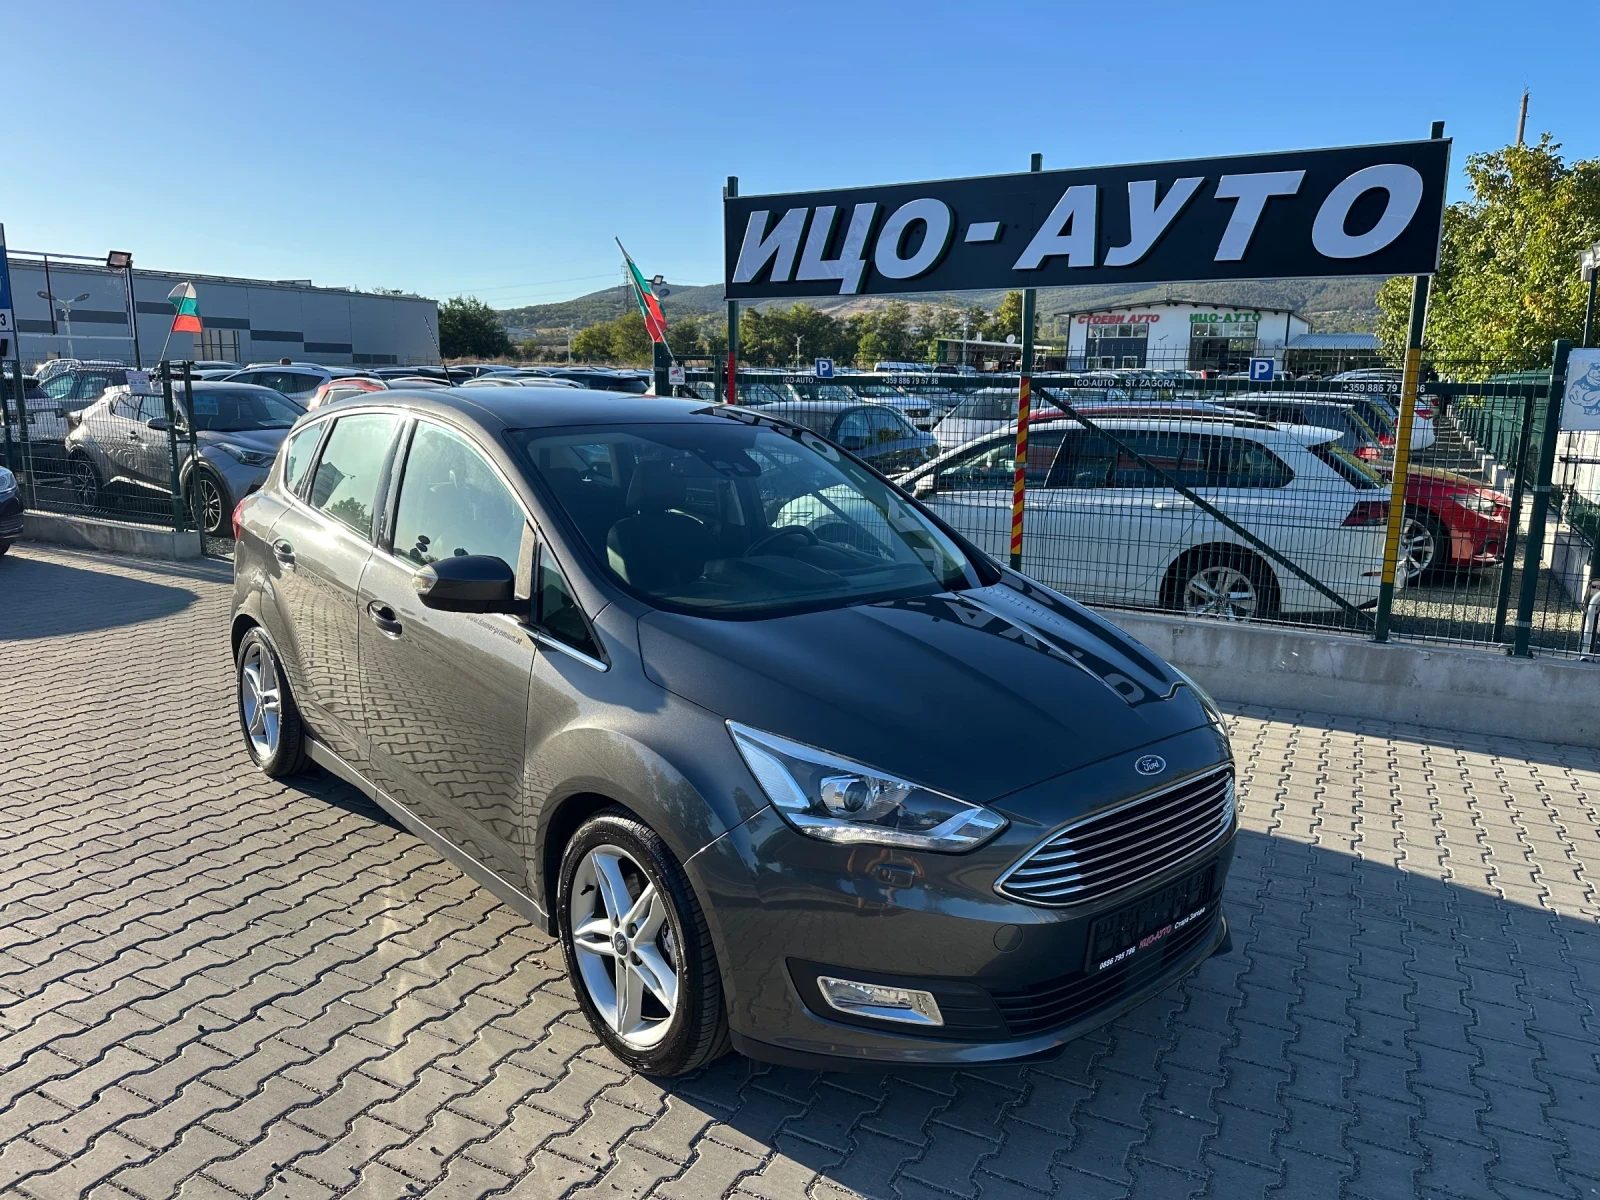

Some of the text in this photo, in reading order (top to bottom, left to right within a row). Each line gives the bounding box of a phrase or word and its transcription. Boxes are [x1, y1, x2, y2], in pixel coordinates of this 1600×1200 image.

[1077, 313, 1160, 325] СТОЕВИ АУТО
[1189, 312, 1262, 323] ИЦО-АУТО
[819, 361, 830, 376] P
[1253, 361, 1270, 379] P
[1139, 379, 1176, 388] ZAGORA
[1343, 383, 1365, 392] +359
[1367, 384, 1384, 392] 886
[1386, 384, 1398, 392] 79
[1099, 957, 1115, 970] 0886
